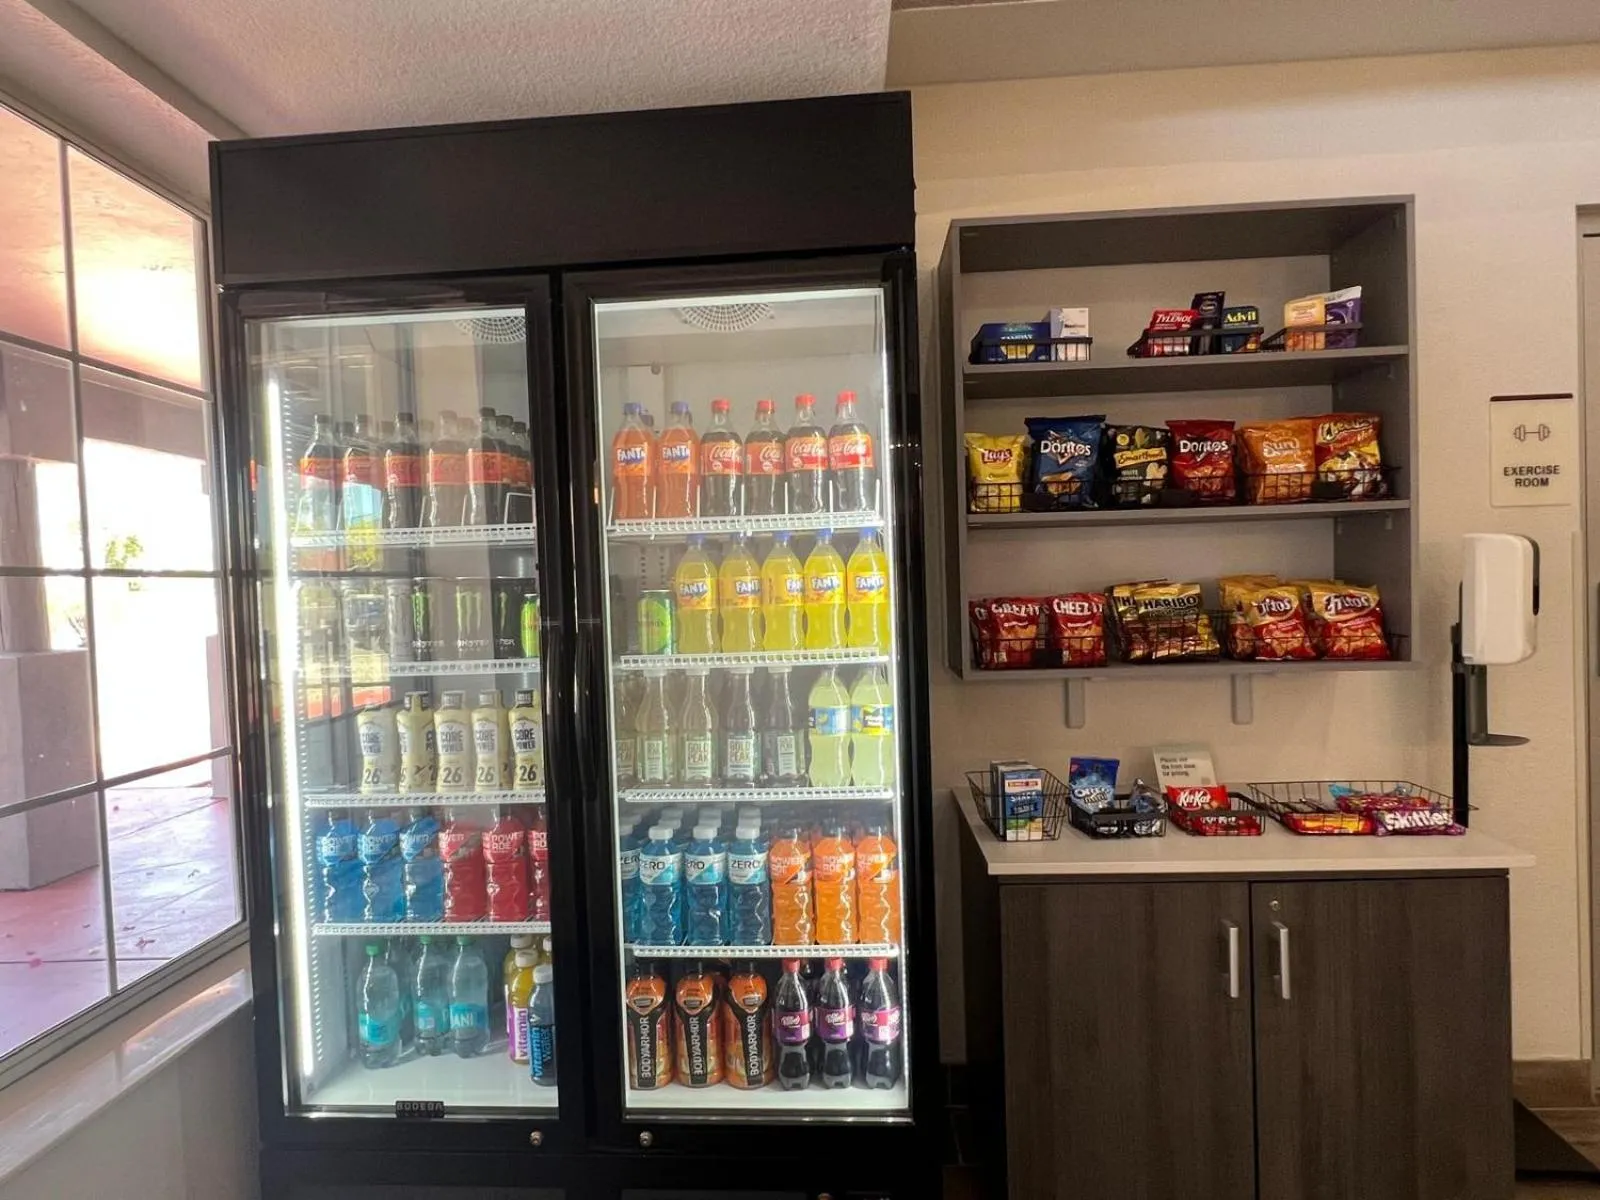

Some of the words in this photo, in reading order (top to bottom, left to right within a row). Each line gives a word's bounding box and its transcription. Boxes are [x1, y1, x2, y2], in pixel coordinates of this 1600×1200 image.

[1155, 312, 1192, 324] TYLENOL
[1224, 311, 1257, 323] Advil
[1040, 438, 1092, 457] Doritos
[1179, 439, 1228, 454] Doritos
[1118, 450, 1164, 465] Smartfood
[1503, 465, 1561, 477] EXERCISE
[1515, 478, 1549, 488] ROOM
[1143, 596, 1198, 610] HARIBO
[1324, 593, 1370, 614] Fritos
[515, 727, 536, 740] CORE
[364, 767, 382, 784] 26
[443, 766, 463, 783] 26
[478, 766, 496, 782] 26
[519, 764, 538, 782] 26
[1385, 808, 1453, 831] Skittles
[731, 859, 761, 871] ZERO
[518, 1009, 527, 1058] vitamin
[747, 1013, 758, 1078] BODYARMOR
